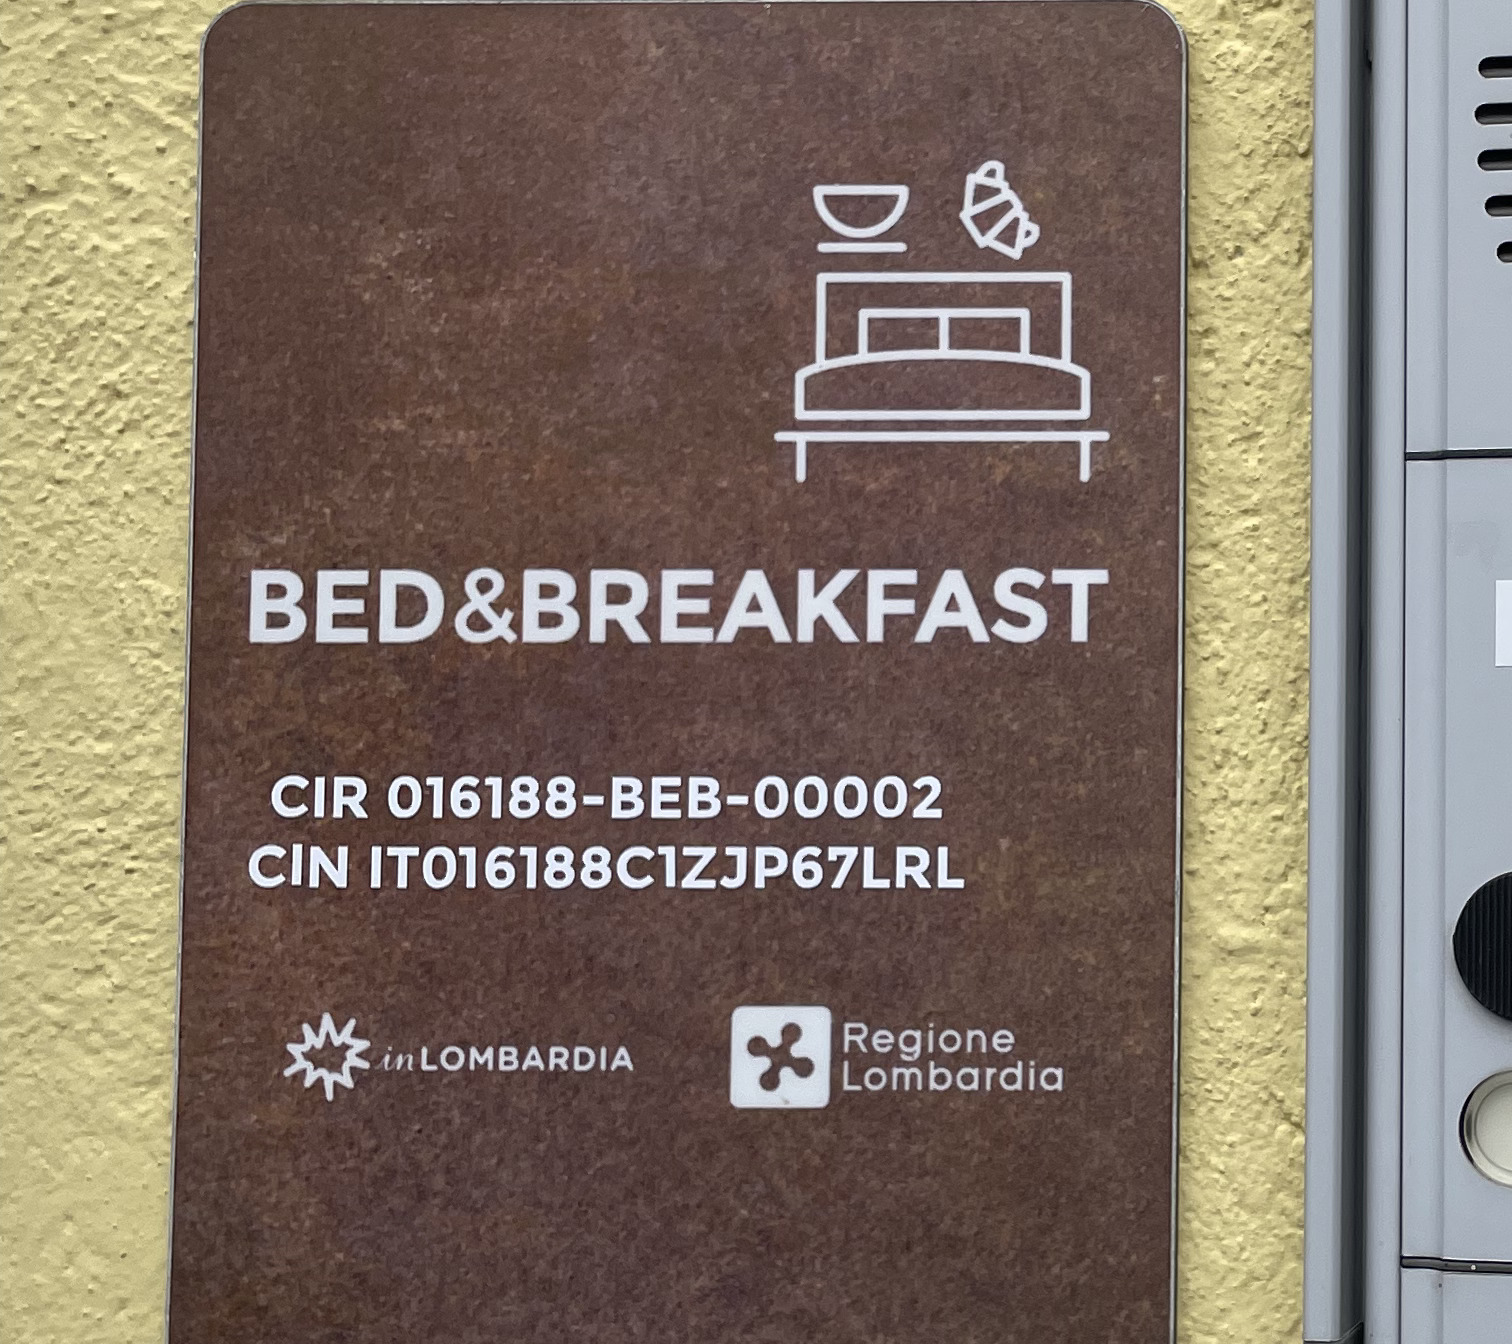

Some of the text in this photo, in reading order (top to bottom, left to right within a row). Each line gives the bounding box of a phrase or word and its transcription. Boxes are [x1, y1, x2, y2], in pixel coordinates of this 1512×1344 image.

[248, 566, 1111, 645] BED&BREAKFAST
[270, 773, 944, 820] CIR 016188-BEB-00002
[247, 842, 966, 890] CIN IT016188C1ZJP67LRL
[842, 1020, 1016, 1059] Regione
[842, 1056, 1065, 1094] Lombardia
